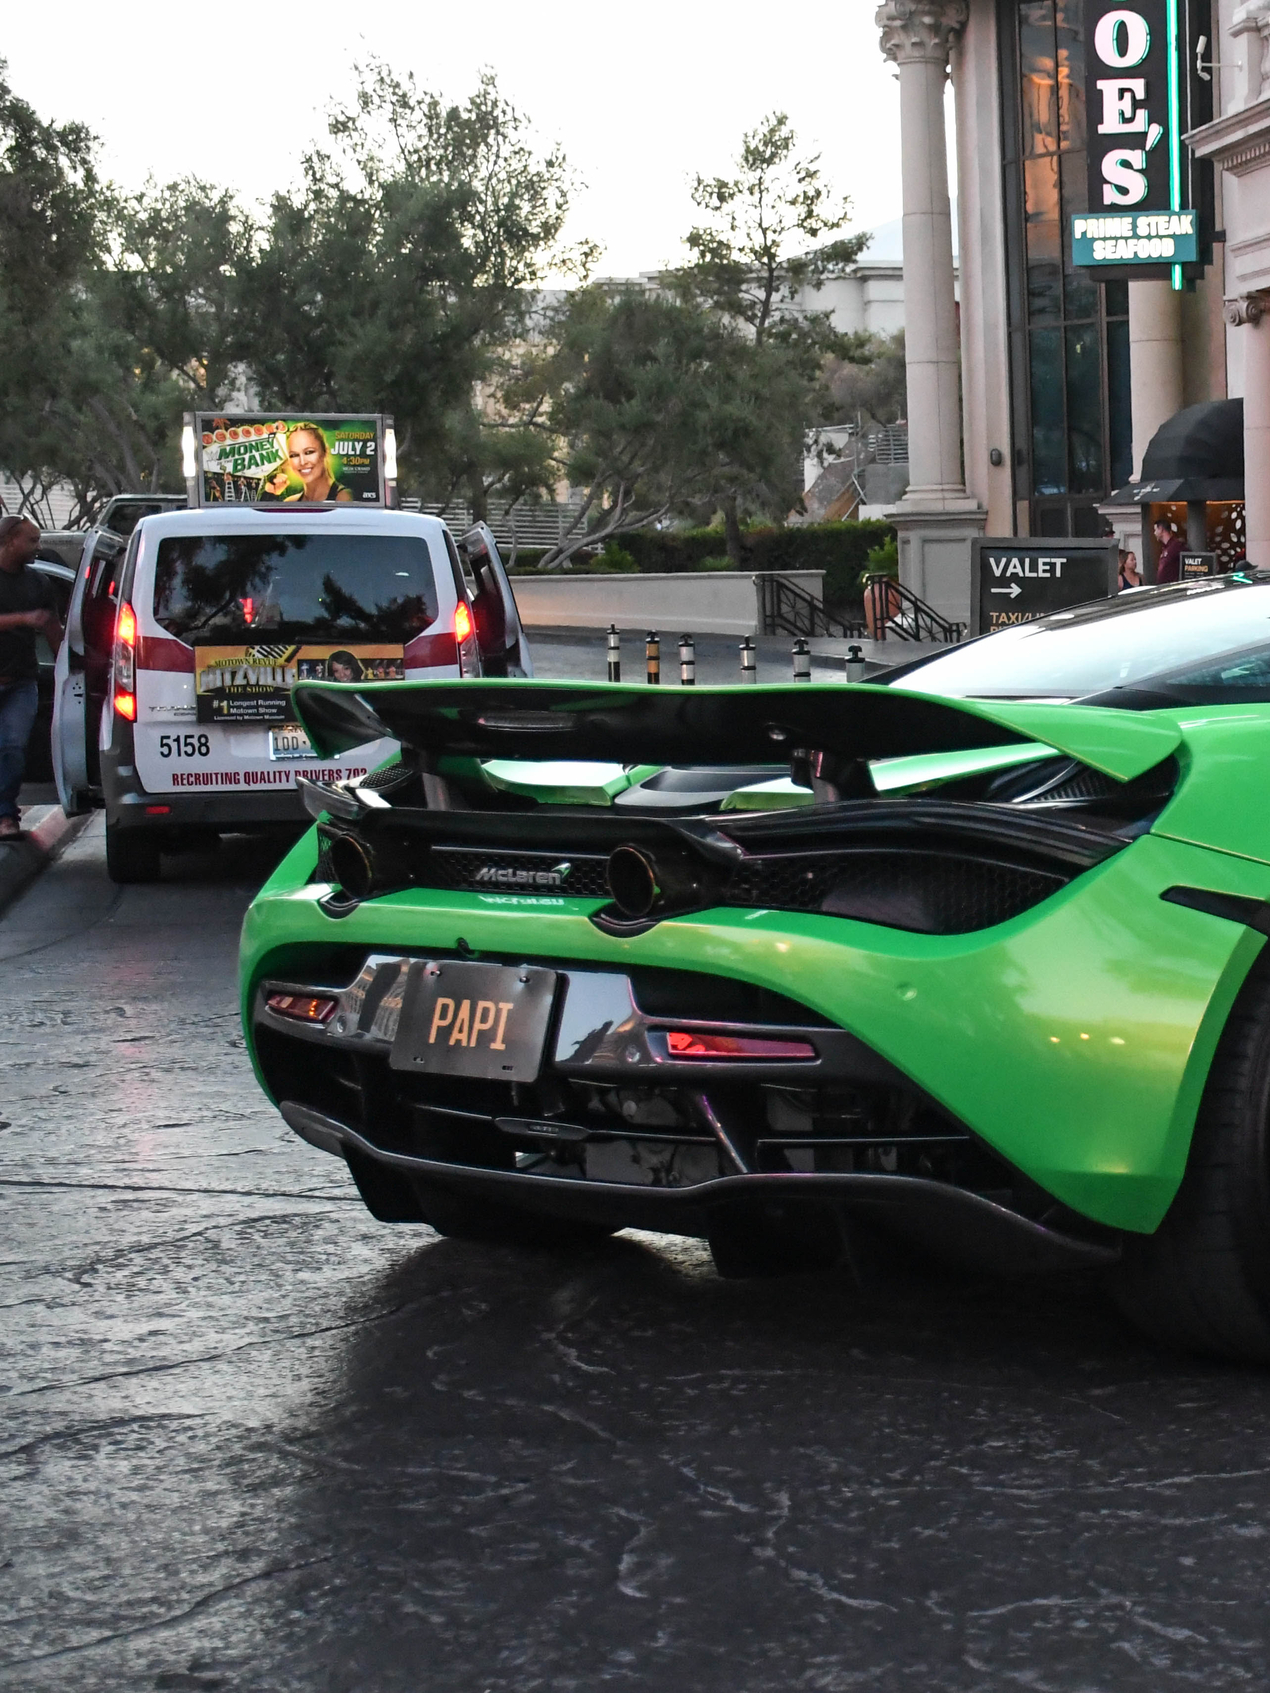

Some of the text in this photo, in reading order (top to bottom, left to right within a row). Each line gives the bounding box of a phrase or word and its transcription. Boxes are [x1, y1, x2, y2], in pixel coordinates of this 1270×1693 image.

[1094, 0, 1164, 206] OE'S
[1074, 215, 1193, 239] PRIME STEAK
[1092, 237, 1175, 260] SEAFOOD
[335, 431, 375, 440] SATURDAY
[219, 437, 275, 461] MONEY
[330, 441, 376, 455] JULY 2
[231, 448, 284, 475] BANK
[341, 456, 370, 466] 4:30PM
[989, 557, 1067, 578] VALET
[1184, 557, 1203, 566] VALET
[214, 658, 250, 668] MOTOWN
[200, 664, 297, 692] HITZVILLE
[225, 685, 275, 694] THE SHOW
[160, 734, 210, 758] 5158
[172, 772, 240, 786] RECRUITING
[243, 770, 290, 786] QUALITY
[295, 768, 342, 782] DRIVERS
[475, 867, 561, 885] McLaren
[428, 997, 514, 1050] PAPI
